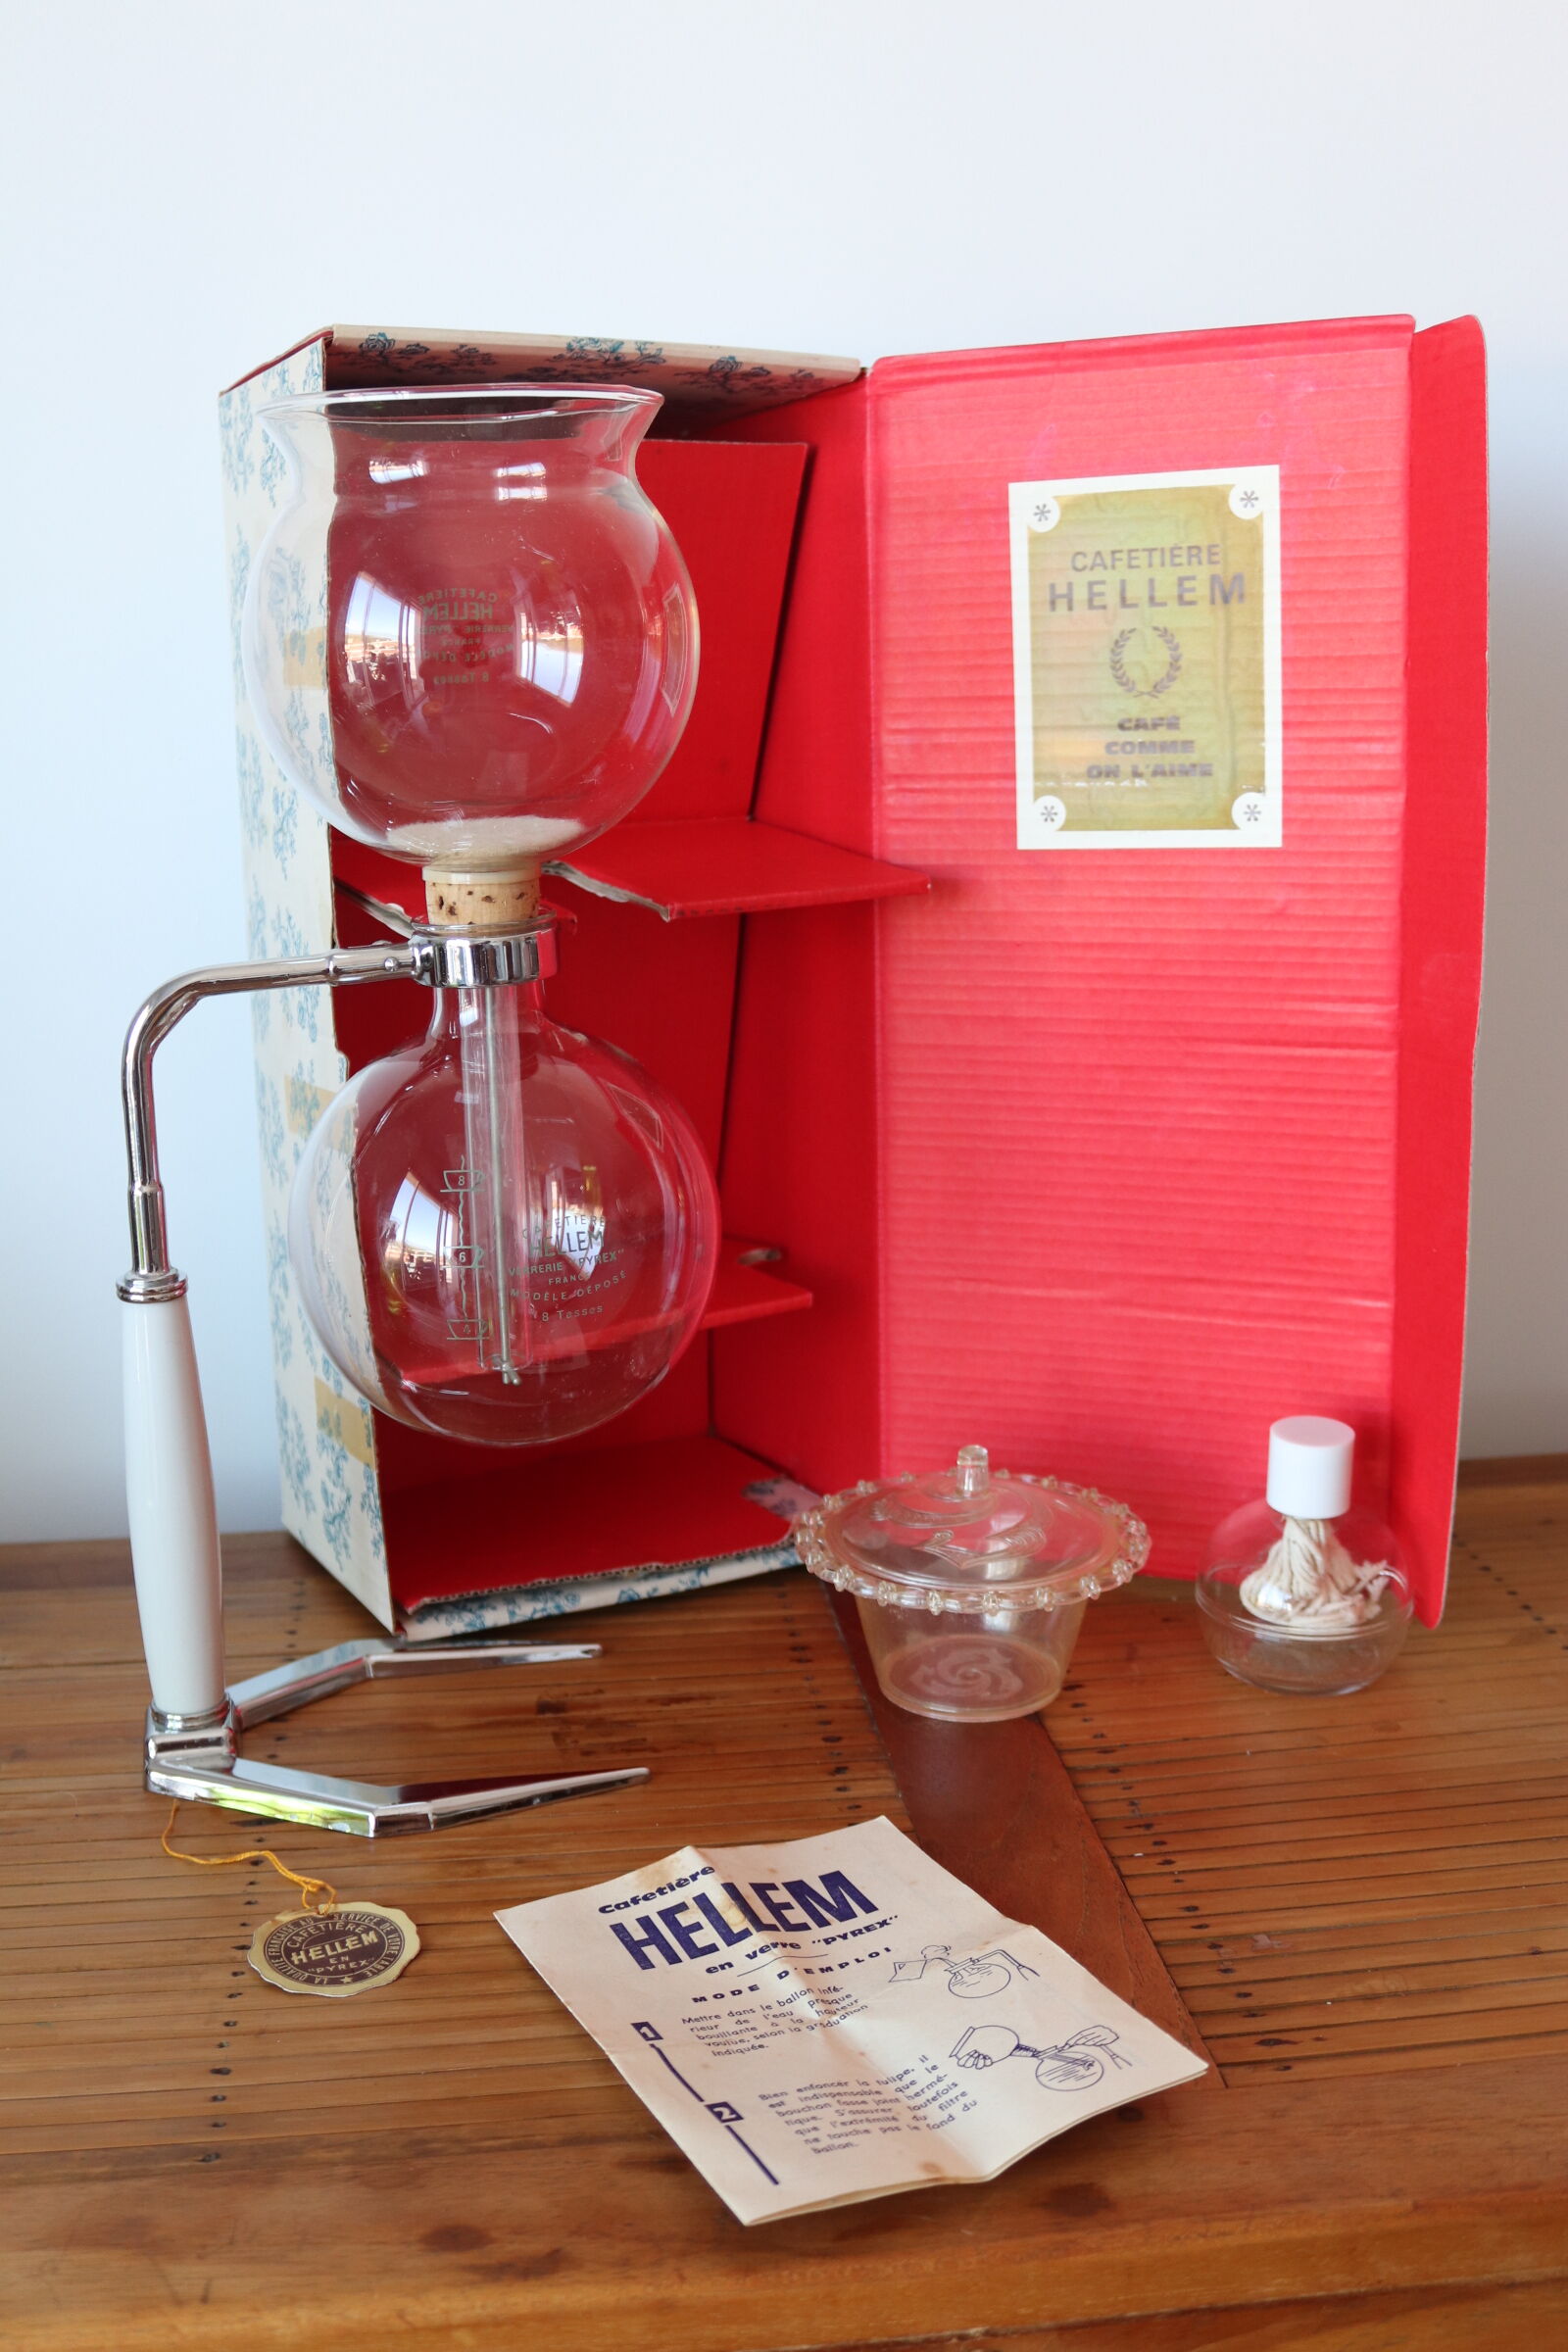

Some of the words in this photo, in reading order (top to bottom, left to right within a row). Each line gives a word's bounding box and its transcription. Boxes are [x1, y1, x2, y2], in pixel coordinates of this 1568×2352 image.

[1049, 571, 1247, 612] HELLEM
[1104, 739, 1196, 756] COMME
[1086, 763, 1120, 779] ON
[1131, 762, 1213, 778] L'AIME
[458, 1175, 466, 1187] 8
[459, 1251, 466, 1263] 6
[530, 1230, 604, 1258] HELLEM
[510, 1262, 564, 1278] VERRERIE
[542, 1312, 550, 1322] 8
[300, 1918, 315, 1928] AU
[333, 1912, 378, 1927] SERVICE
[380, 1923, 393, 1934] DE
[610, 1870, 879, 1971] HELLEM
[291, 1930, 378, 1965] HELLEM
[329, 1955, 349, 1964] EN
[705, 1961, 734, 1974] en
[745, 1941, 802, 1960] verre
[692, 1984, 760, 2003] MODE
[776, 1947, 892, 1980] D'EMPLOI
[681, 2013, 721, 2026] Mettre
[727, 2007, 756, 2018] dans
[776, 1987, 813, 2008] ballon
[690, 2024, 720, 2033] rieur
[762, 2010, 794, 2021] l'eau
[808, 1992, 853, 2009] presque
[696, 2026, 759, 2040] bouillante
[814, 1998, 860, 2018] hauteur
[753, 2030, 785, 2040] selon
[759, 2091, 788, 2101] Bien
[796, 2082, 849, 2093] enfoncer
[768, 2100, 786, 2109] est
[798, 2089, 883, 2103] indispensable
[895, 2079, 917, 2094] que
[925, 2064, 939, 2075] le
[907, 2082, 958, 2112] toutefois
[775, 2102, 832, 2118] bouchon
[795, 2126, 820, 2136] que
[938, 2090, 968, 2112] filtre
[827, 2129, 871, 2140] touche
[878, 2126, 902, 2134] pas
[926, 2113, 956, 2131] fond
[961, 2099, 978, 2112] du
